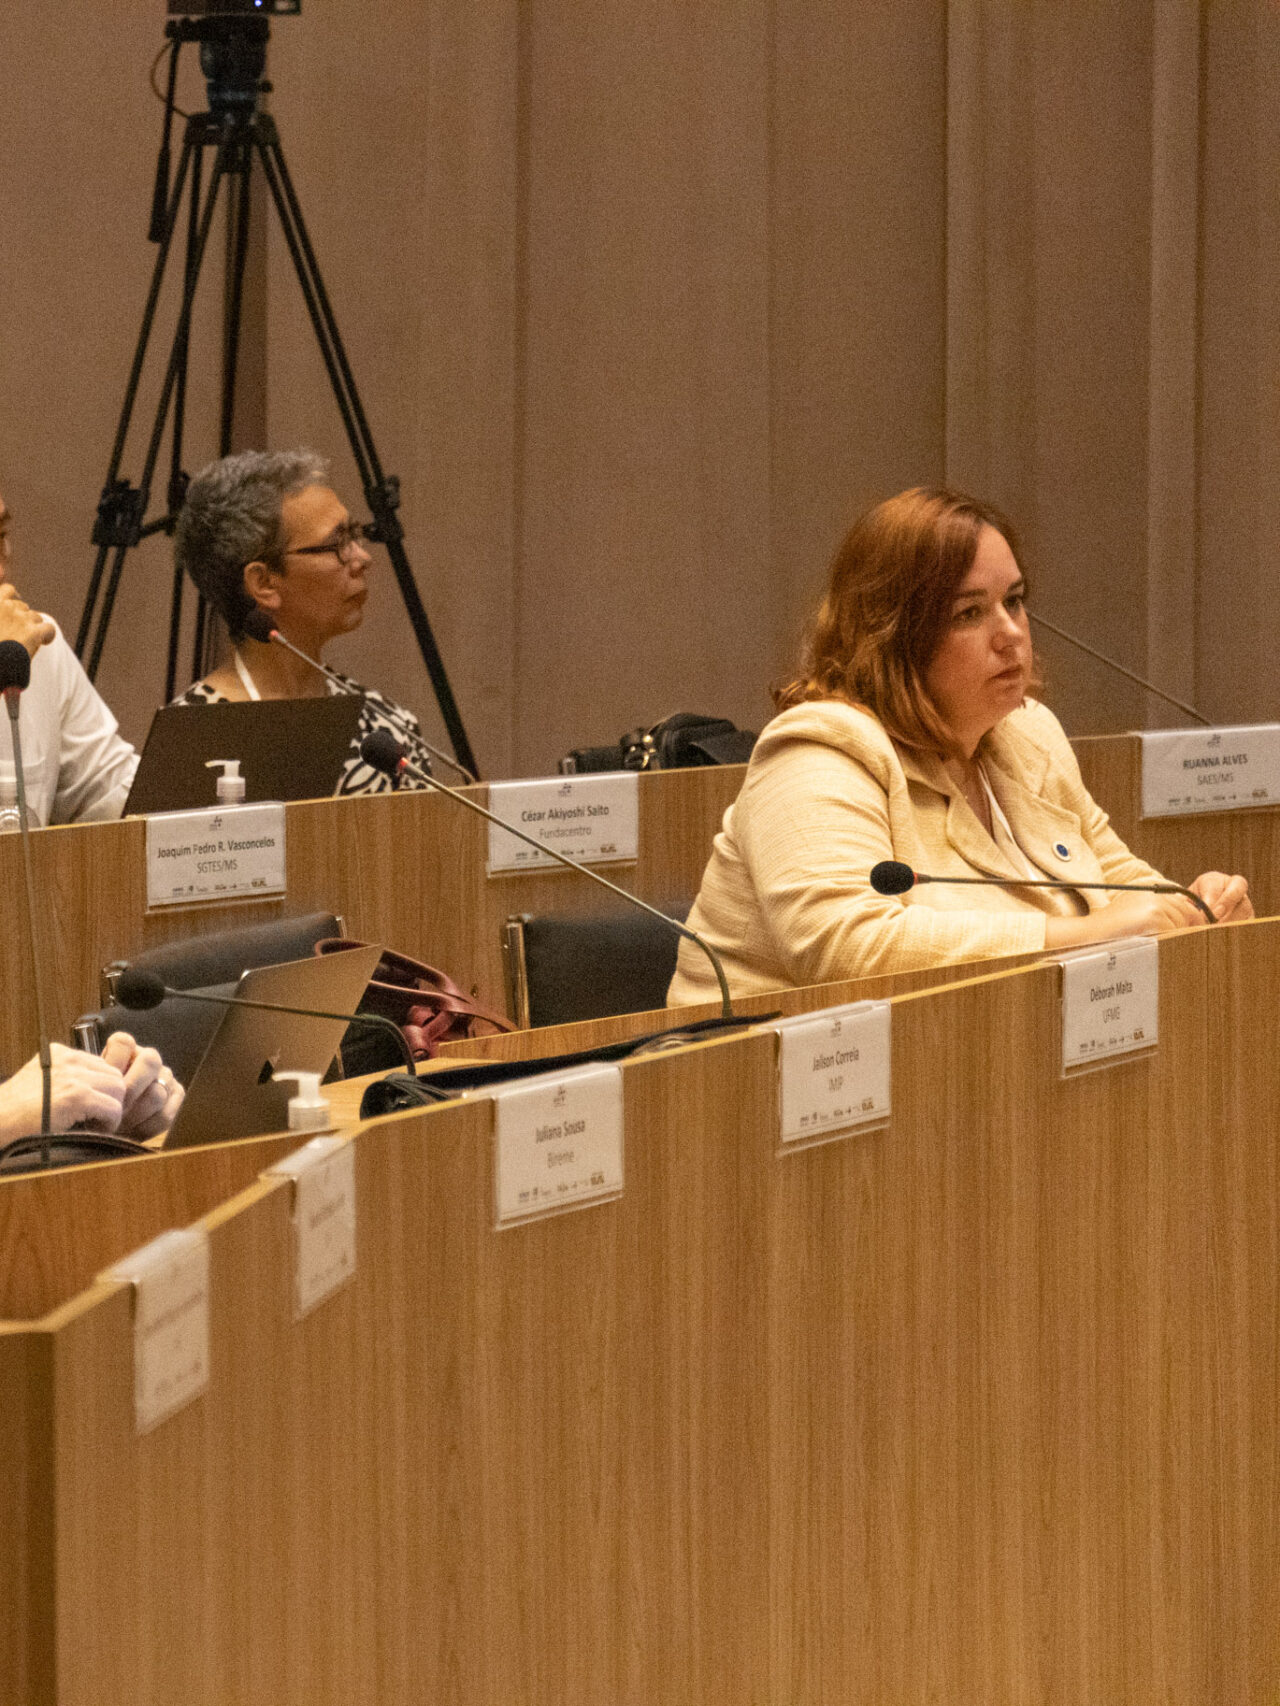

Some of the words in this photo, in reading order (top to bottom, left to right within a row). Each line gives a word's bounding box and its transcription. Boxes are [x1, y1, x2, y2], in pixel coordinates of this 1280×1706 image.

[587, 804, 609, 816] Saito
[539, 826, 592, 839] Fundacentro
[158, 846, 191, 858] Joaquim
[193, 843, 216, 854] Pedro
[228, 837, 275, 850] Vasconcelos
[197, 860, 238, 873] SGTES/MS
[835, 1047, 859, 1065] Correia
